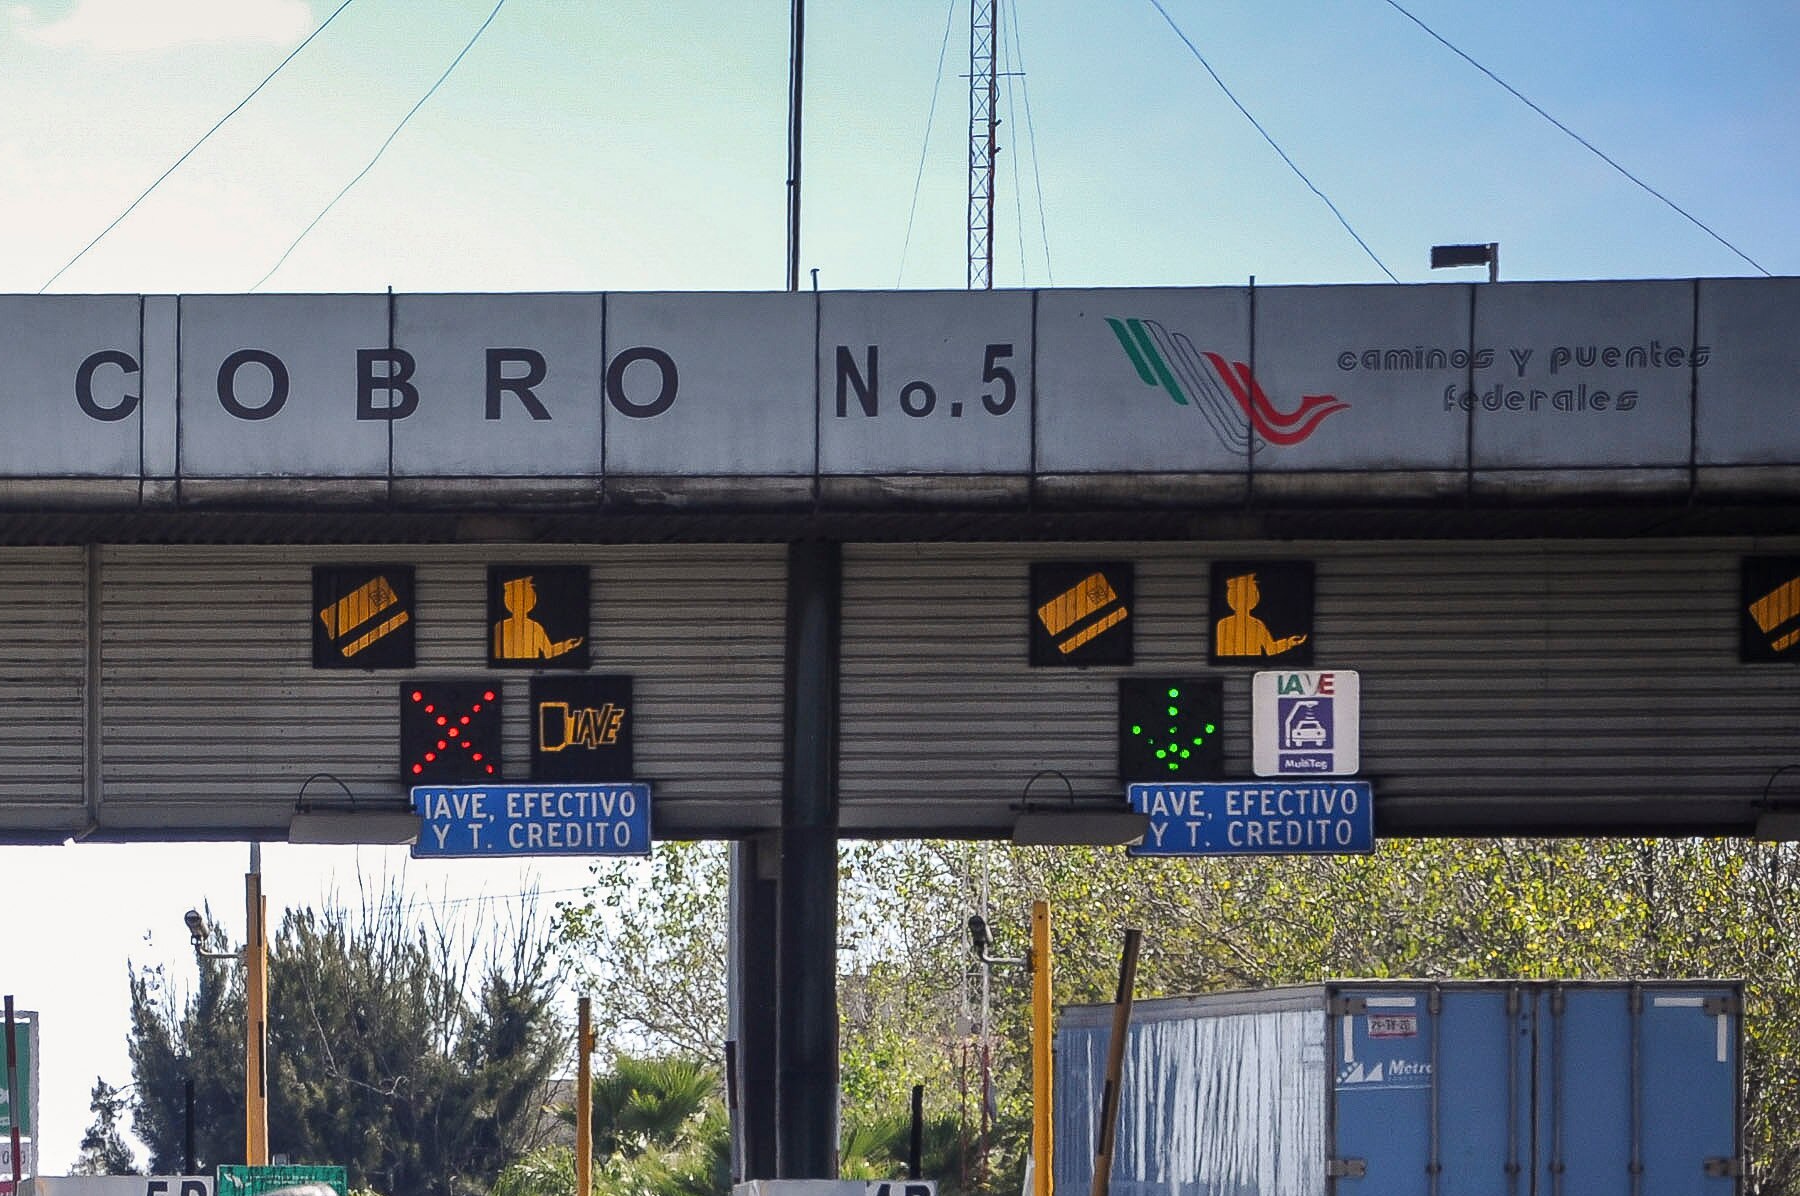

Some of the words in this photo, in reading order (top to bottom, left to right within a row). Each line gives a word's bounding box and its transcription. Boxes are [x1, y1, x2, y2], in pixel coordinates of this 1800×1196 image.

[1549, 340, 1711, 375] puentes
[74, 346, 680, 422] COBRO
[1443, 384, 1640, 412] federales
[1277, 673, 1335, 696] IAVE
[424, 793, 495, 823] IAVE,
[506, 790, 636, 819] EFECTIVO
[1142, 790, 1214, 821] IAVE,
[1225, 789, 1358, 817] EFECTIVO
[432, 823, 451, 850] Y
[467, 823, 493, 849] T.
[508, 821, 631, 849] CREDITO
[1149, 821, 1170, 848] Y
[1186, 821, 1212, 847] T.
[1227, 819, 1353, 847] CREDITO
